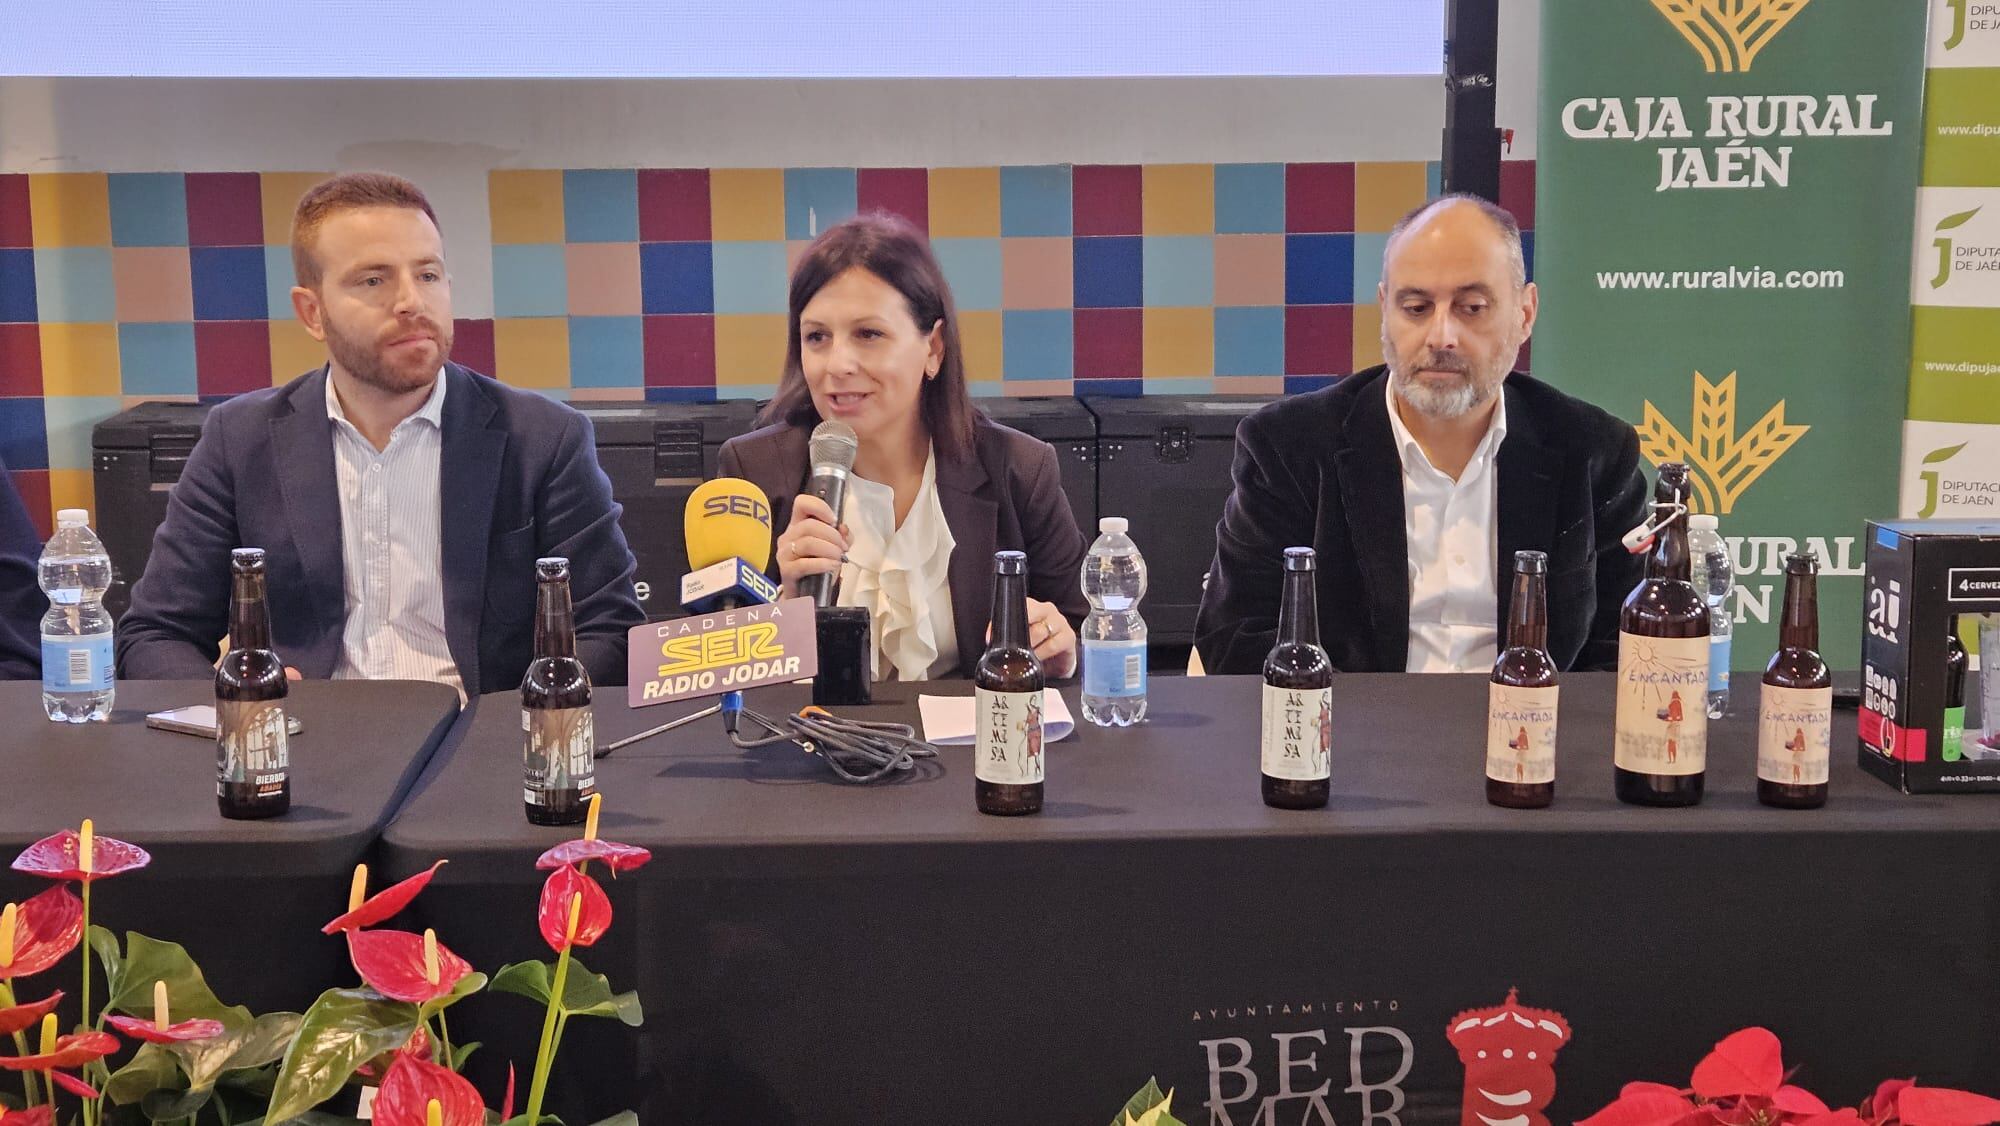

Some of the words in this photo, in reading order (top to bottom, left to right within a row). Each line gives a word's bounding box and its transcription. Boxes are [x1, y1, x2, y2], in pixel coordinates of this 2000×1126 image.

[1970, 20, 1988, 29] DE
[1562, 97, 1692, 141] CAJA
[1706, 94, 1893, 137] RURAL
[1656, 138, 1793, 192] JAÉN
[1597, 266, 1844, 289] www.ruralvia.com
[1955, 260, 1972, 270] DE
[703, 495, 770, 529] SER
[1942, 494, 1959, 504] DE
[1962, 495, 1994, 505] JAÉN
[1725, 537, 1866, 576] URAL
[657, 606, 783, 638] CADENA
[658, 622, 784, 677] SER
[643, 671, 715, 700] RADIO
[721, 656, 801, 687] JODAR
[1192, 1000, 1399, 1021] AYUNTAMIENTO
[1199, 1026, 1414, 1104] BED
